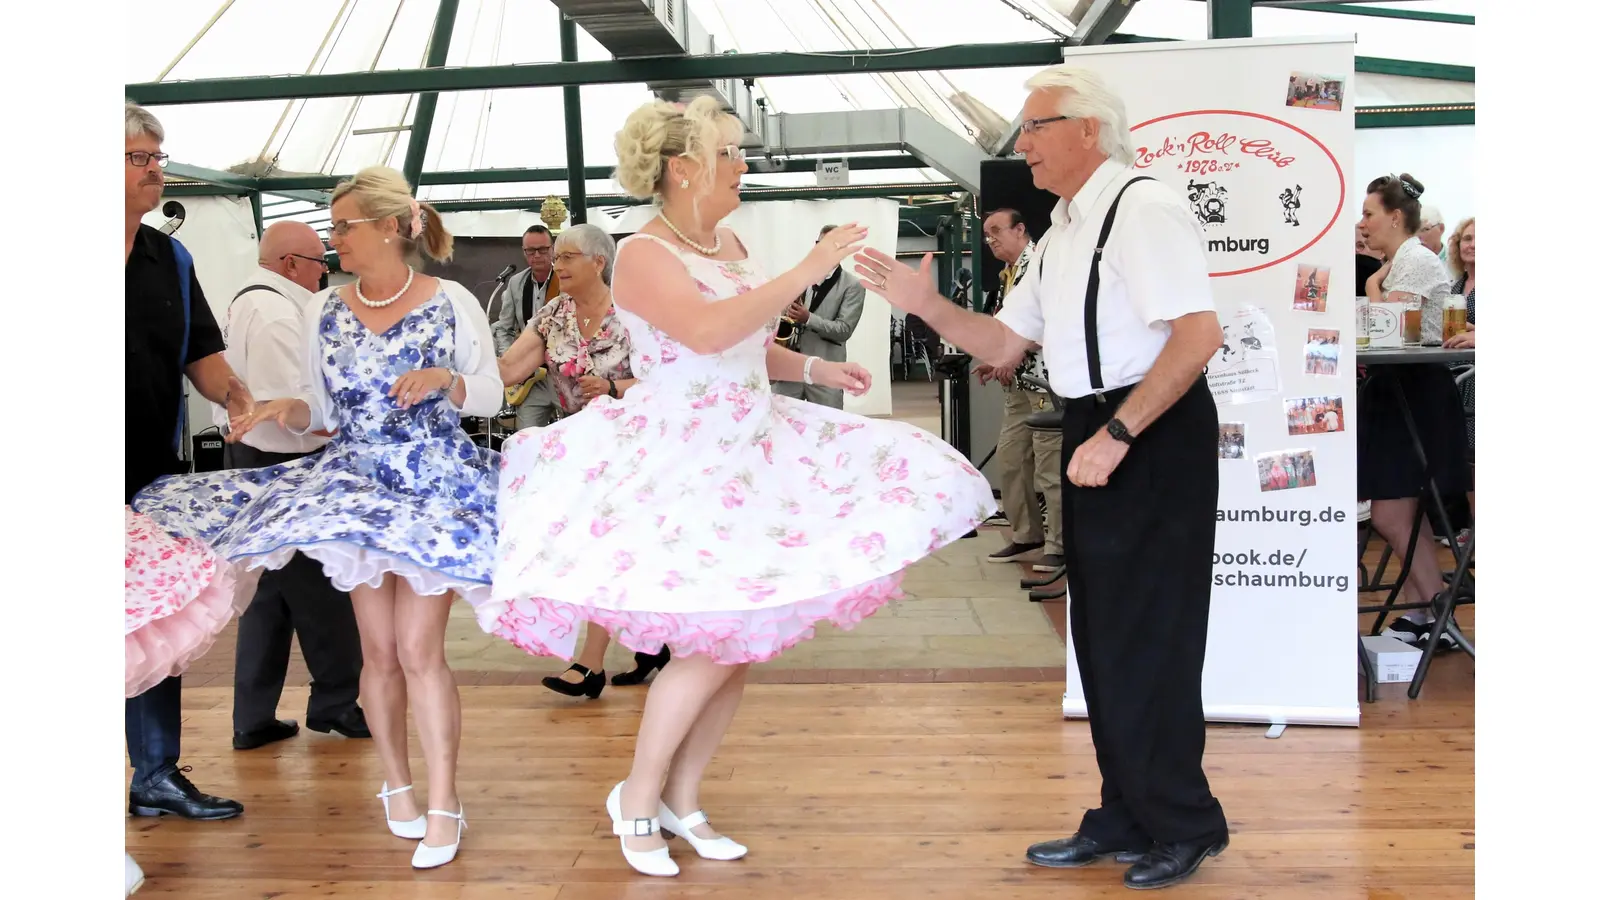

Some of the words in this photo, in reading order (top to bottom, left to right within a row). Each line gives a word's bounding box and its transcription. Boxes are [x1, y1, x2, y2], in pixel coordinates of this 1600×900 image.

[1187, 131, 1237, 157] Roll
[1184, 159, 1218, 175] 1978
[1208, 236, 1270, 254] mburg
[1216, 506, 1346, 526] aumburg.de
[1213, 549, 1308, 568] ook.de/
[1214, 570, 1349, 592] schaumburg
